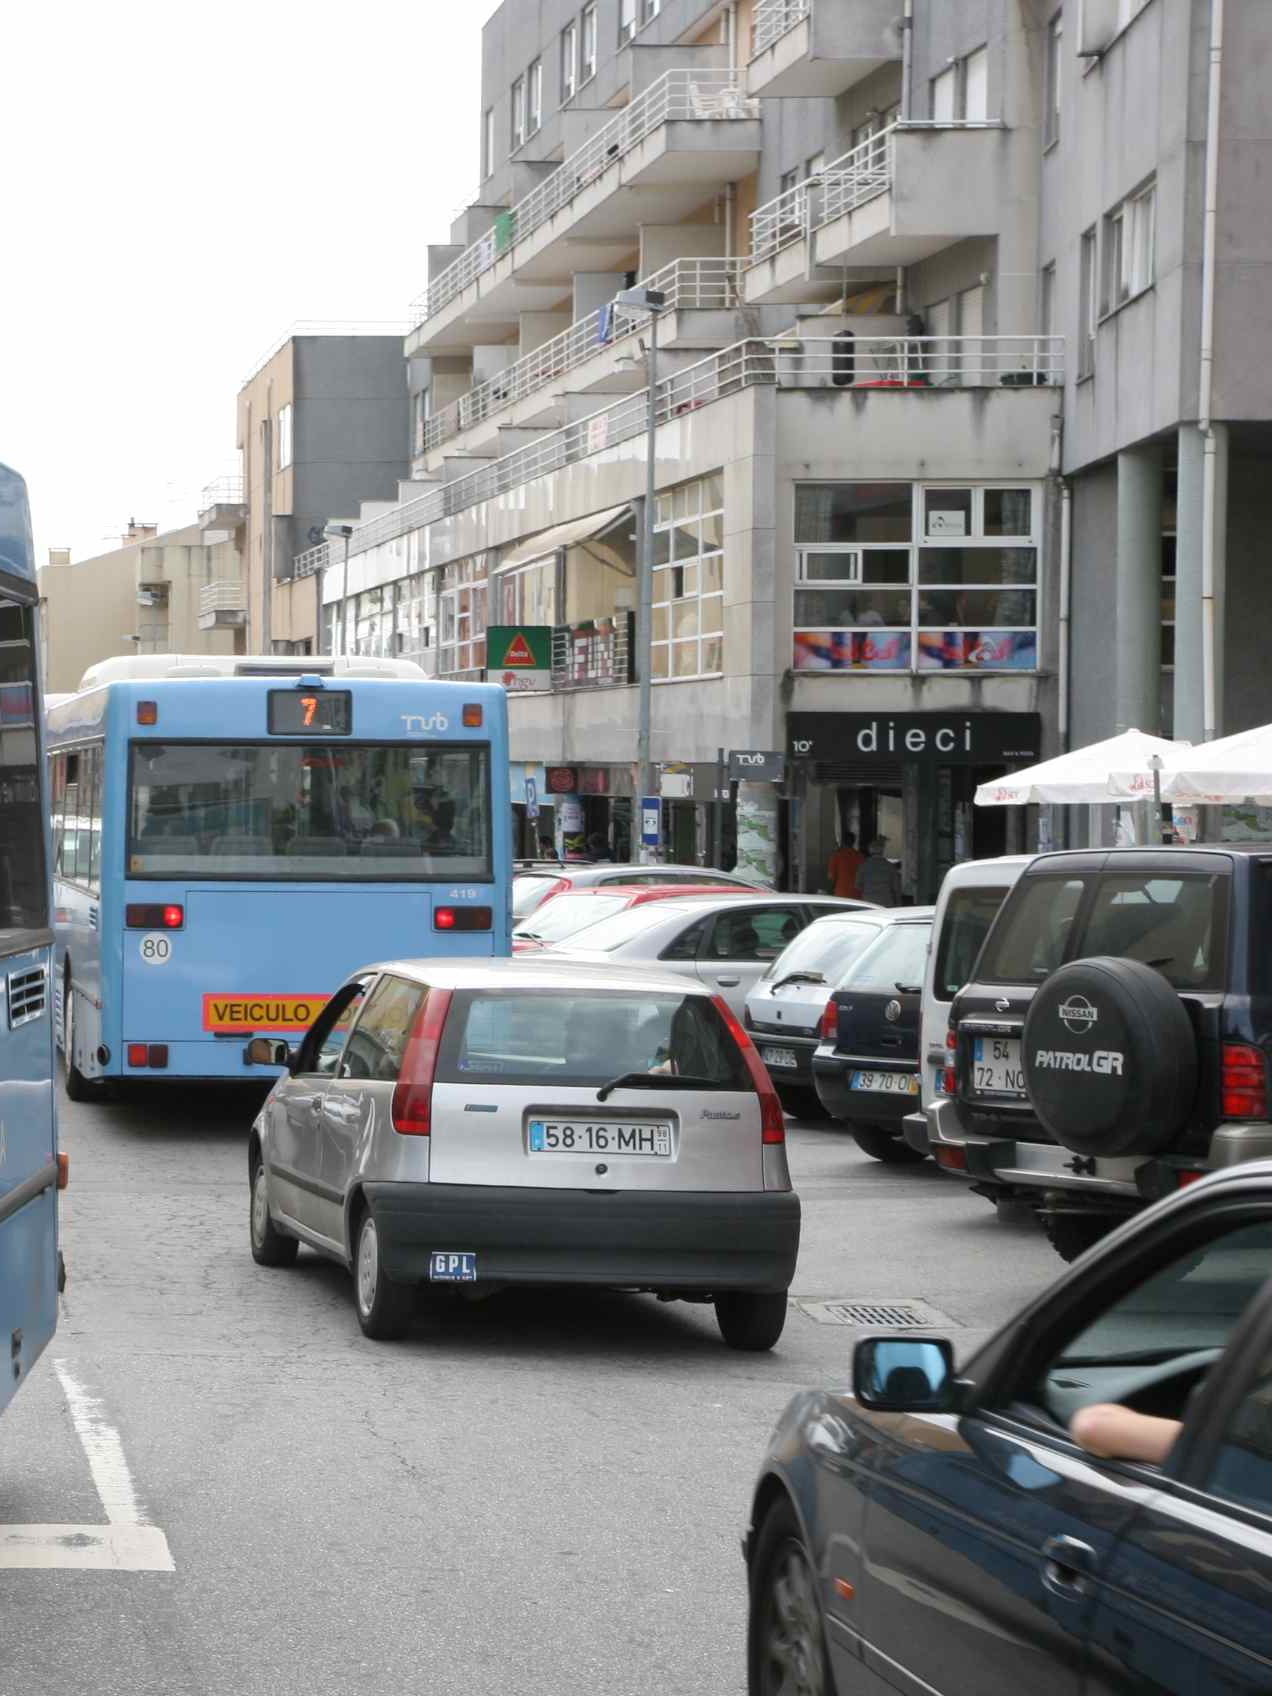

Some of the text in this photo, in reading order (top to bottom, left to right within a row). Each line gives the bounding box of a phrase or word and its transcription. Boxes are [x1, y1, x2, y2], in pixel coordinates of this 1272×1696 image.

[299, 696, 318, 726] 7
[856, 721, 971, 752] dieci
[143, 939, 169, 958] 80
[213, 1003, 311, 1023] VEICULO
[1062, 1007, 1095, 1019] NISSAN
[992, 1040, 1009, 1061] 54
[435, 1255, 471, 1274] GPL
